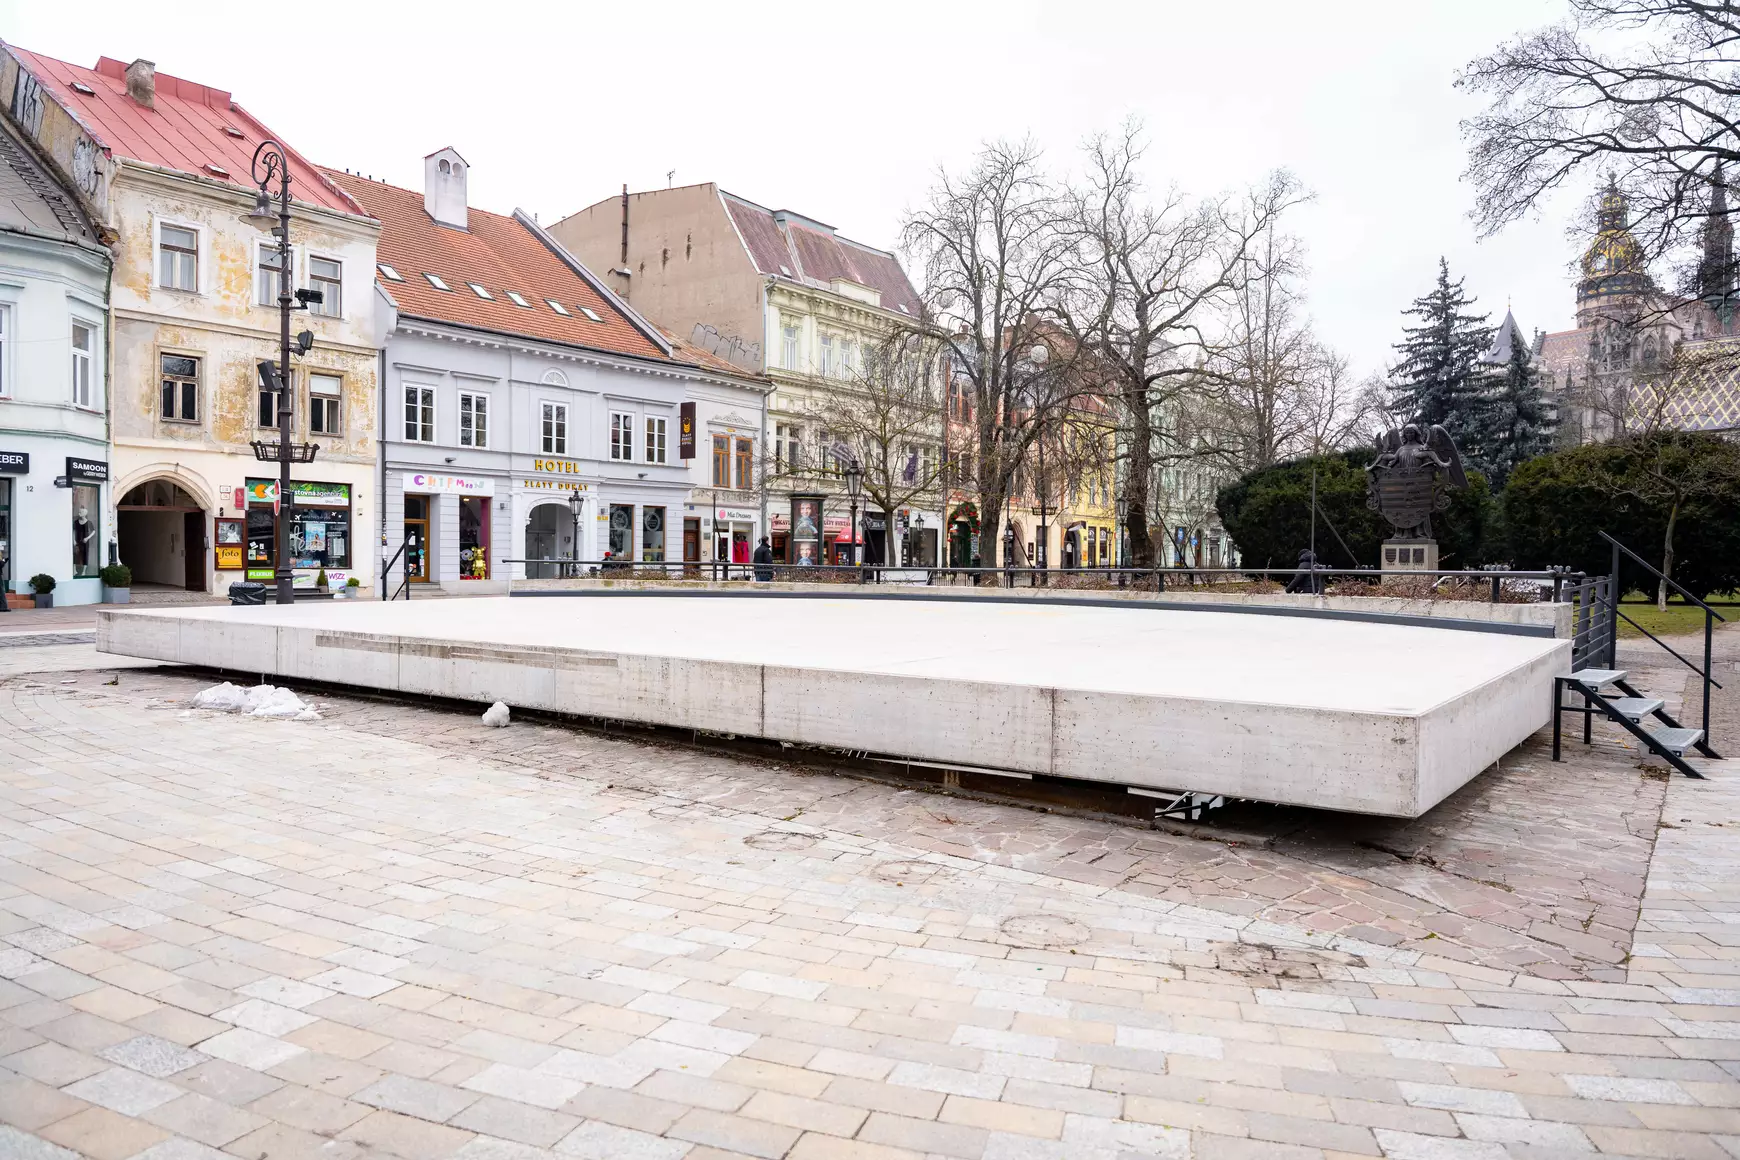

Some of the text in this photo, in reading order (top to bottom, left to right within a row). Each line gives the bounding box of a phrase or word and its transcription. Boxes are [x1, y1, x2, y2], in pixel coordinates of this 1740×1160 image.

[72, 461, 107, 473] SAMOON
[534, 459, 580, 474] HOTEL
[219, 548, 240, 560] foto
